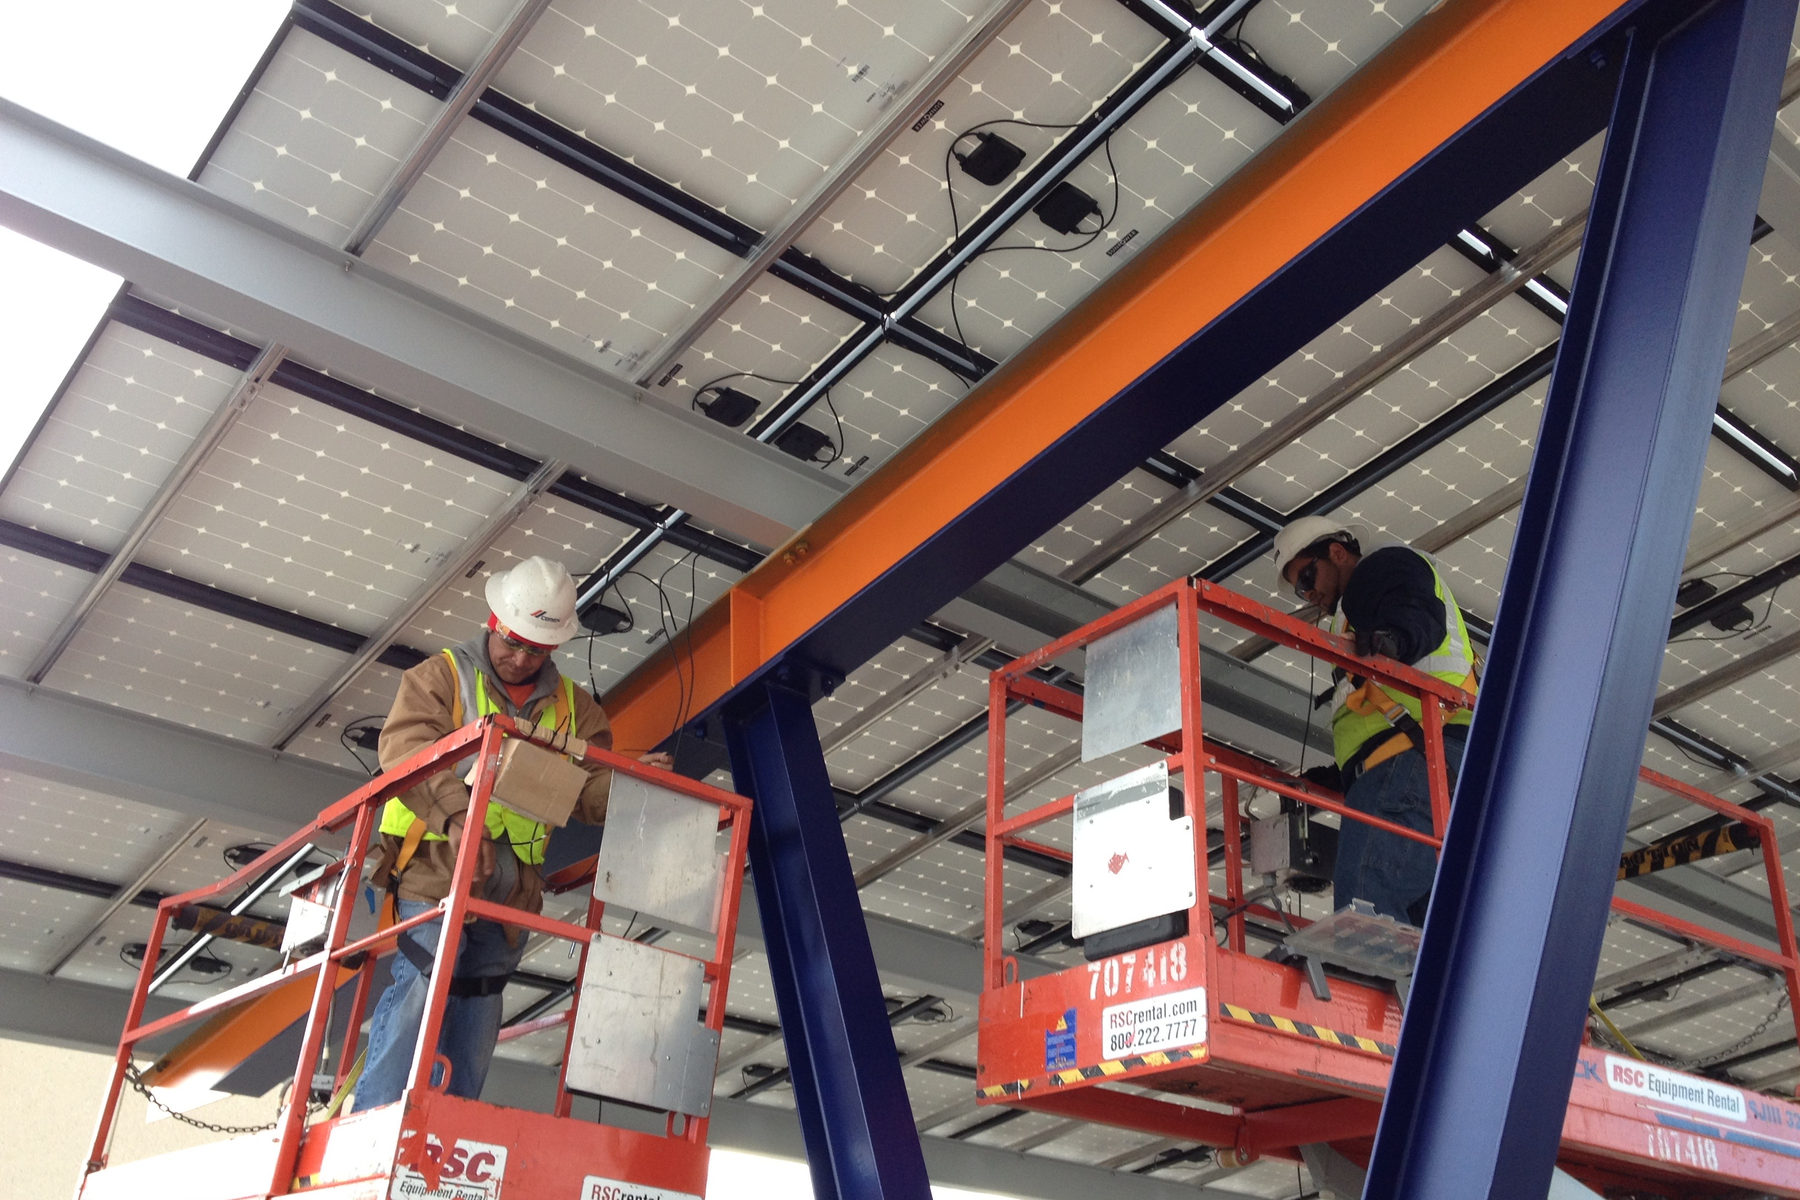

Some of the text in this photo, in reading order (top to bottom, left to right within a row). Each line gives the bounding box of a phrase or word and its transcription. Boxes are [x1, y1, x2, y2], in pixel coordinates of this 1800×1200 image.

[1087, 942, 1187, 1000] 707418
[1110, 1000, 1198, 1030] RSCrental.com
[1110, 1019, 1197, 1052] 800.222.7777
[1613, 1064, 1740, 1113] RSC Equipment Rental
[1645, 1124, 1719, 1171] 707418
